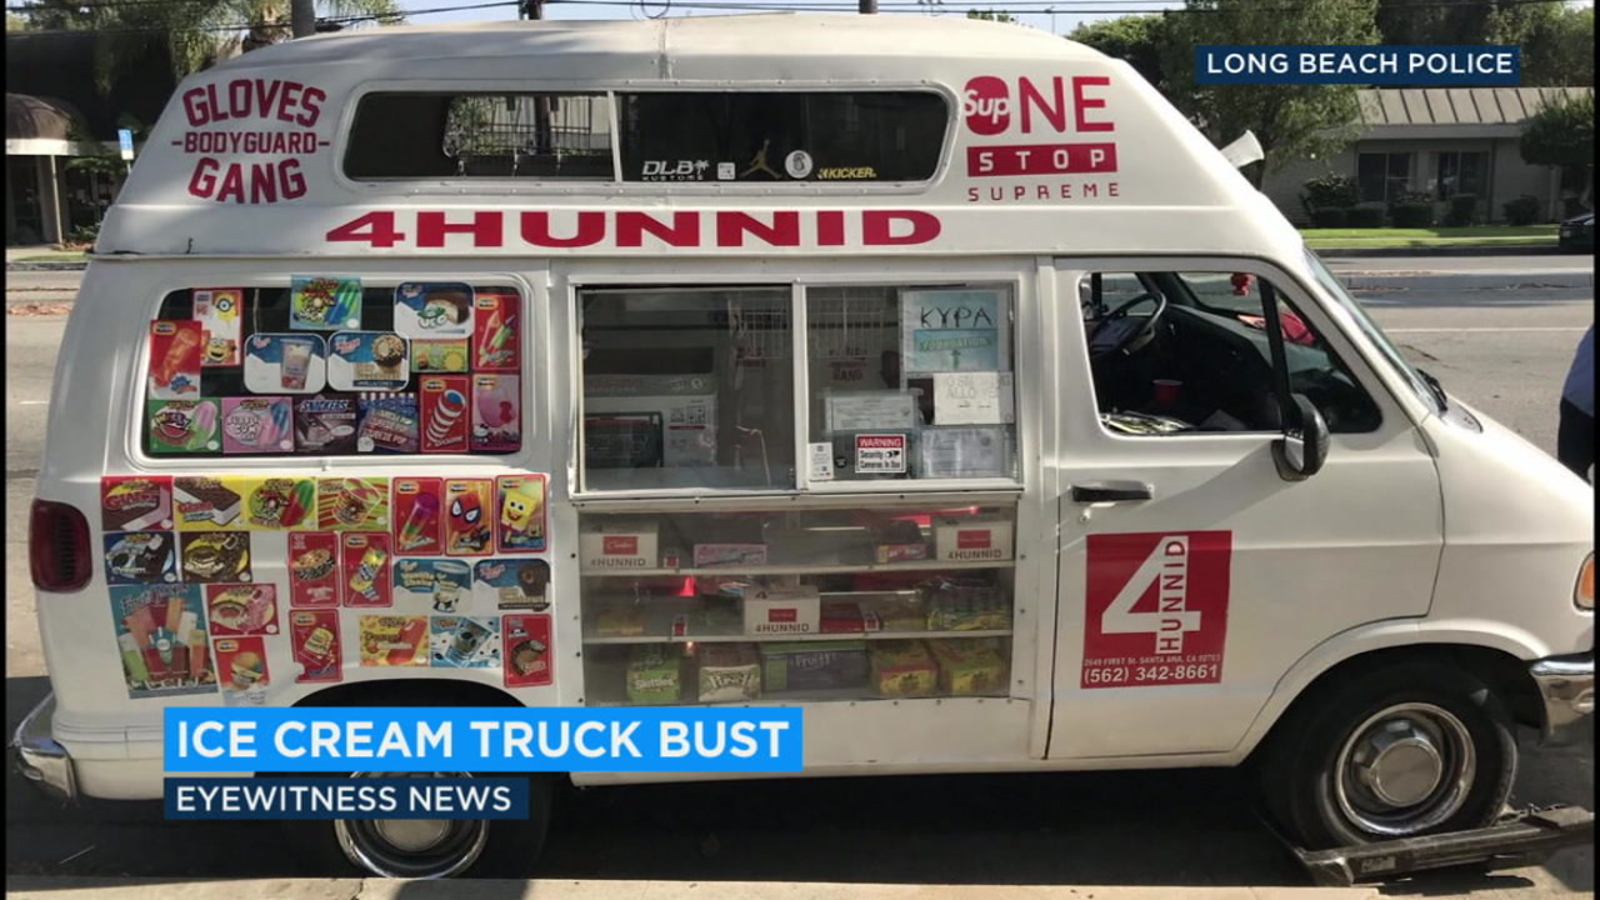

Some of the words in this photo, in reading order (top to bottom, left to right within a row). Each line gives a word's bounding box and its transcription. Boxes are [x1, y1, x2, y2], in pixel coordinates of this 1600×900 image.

[182, 78, 327, 128] GLOVES
[964, 89, 1011, 125] Sup
[641, 160, 695, 175] DLB
[978, 149, 1106, 173] STOP
[187, 156, 308, 204] GANG
[967, 182, 1120, 202] SUPREME
[325, 209, 942, 248] 4HUNNID
[920, 305, 994, 329] KYPA
[859, 438, 901, 448] WARNING
[1159, 540, 1186, 651] HUNNID
[1084, 666, 1129, 684] (562)
[1135, 664, 1218, 681] 342-8661
